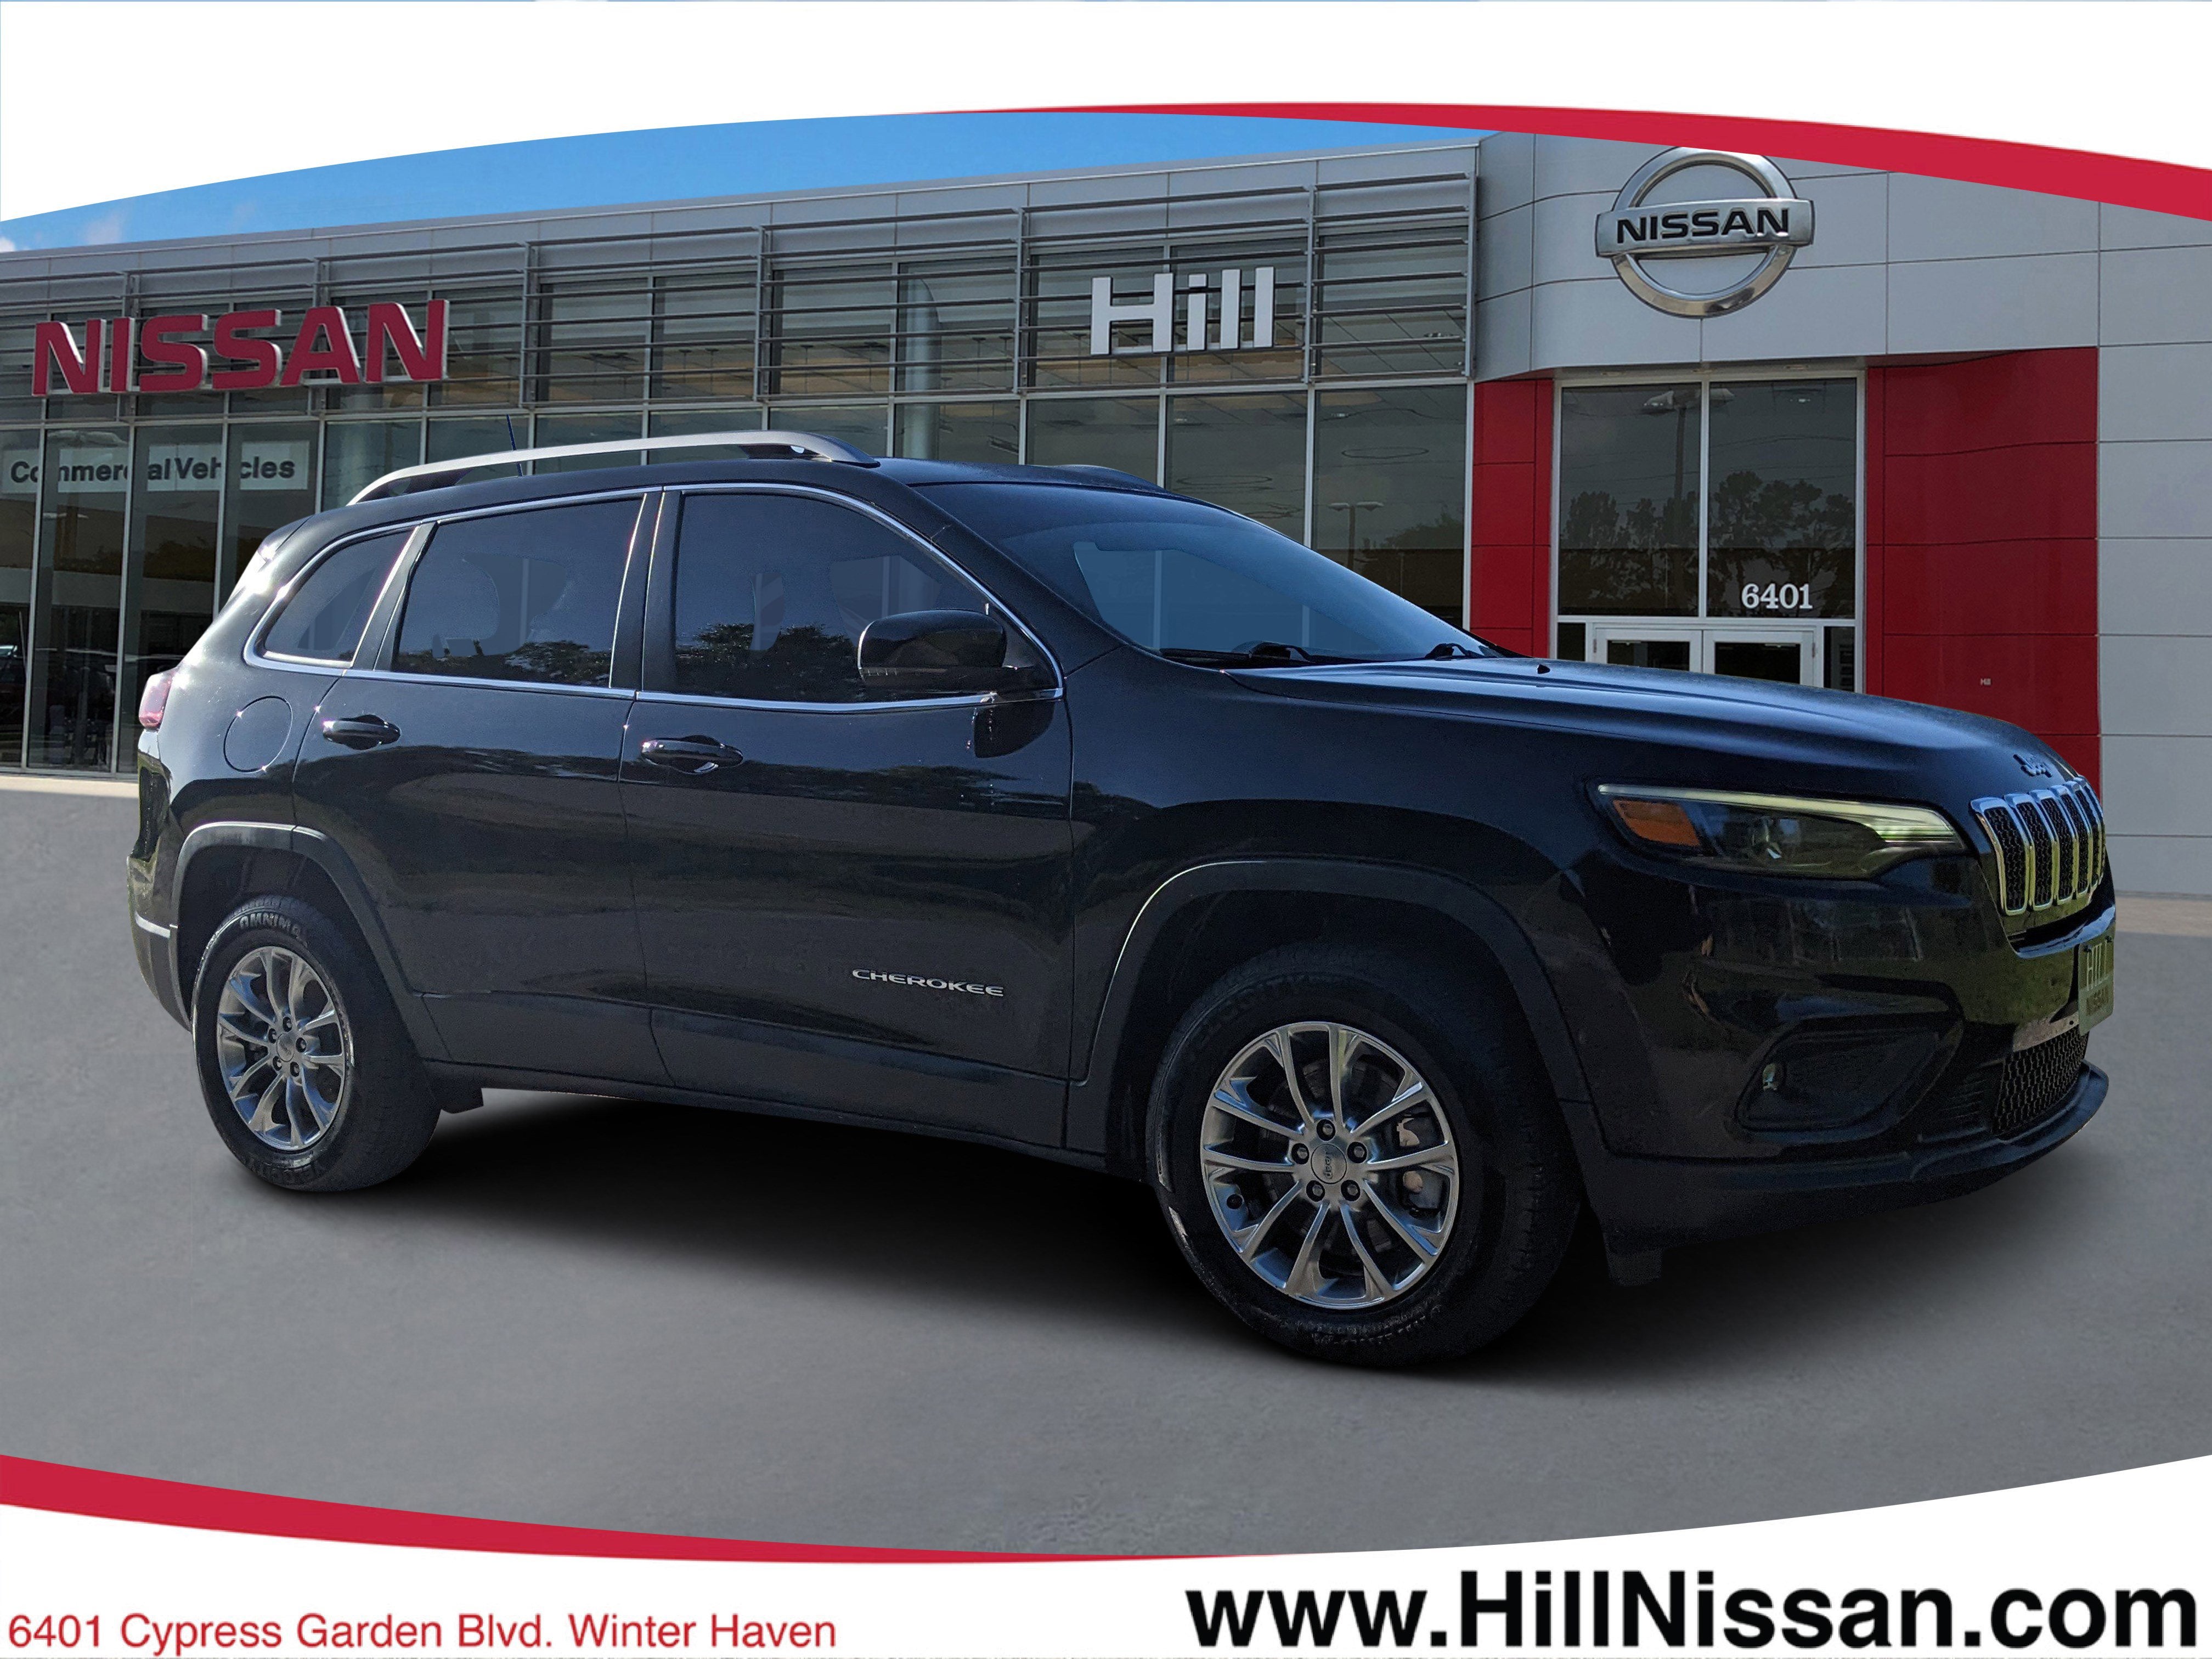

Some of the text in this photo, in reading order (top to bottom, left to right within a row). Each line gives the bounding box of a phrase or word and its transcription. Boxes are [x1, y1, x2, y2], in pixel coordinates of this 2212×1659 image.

[1616, 207, 1790, 244] NISSAN
[1090, 266, 1274, 356] Hill
[31, 300, 449, 396] NISSAN
[10, 456, 296, 483] Comeral Vehcles
[1741, 583, 1813, 609] 6401
[852, 969, 1004, 997] CHEROKEE
